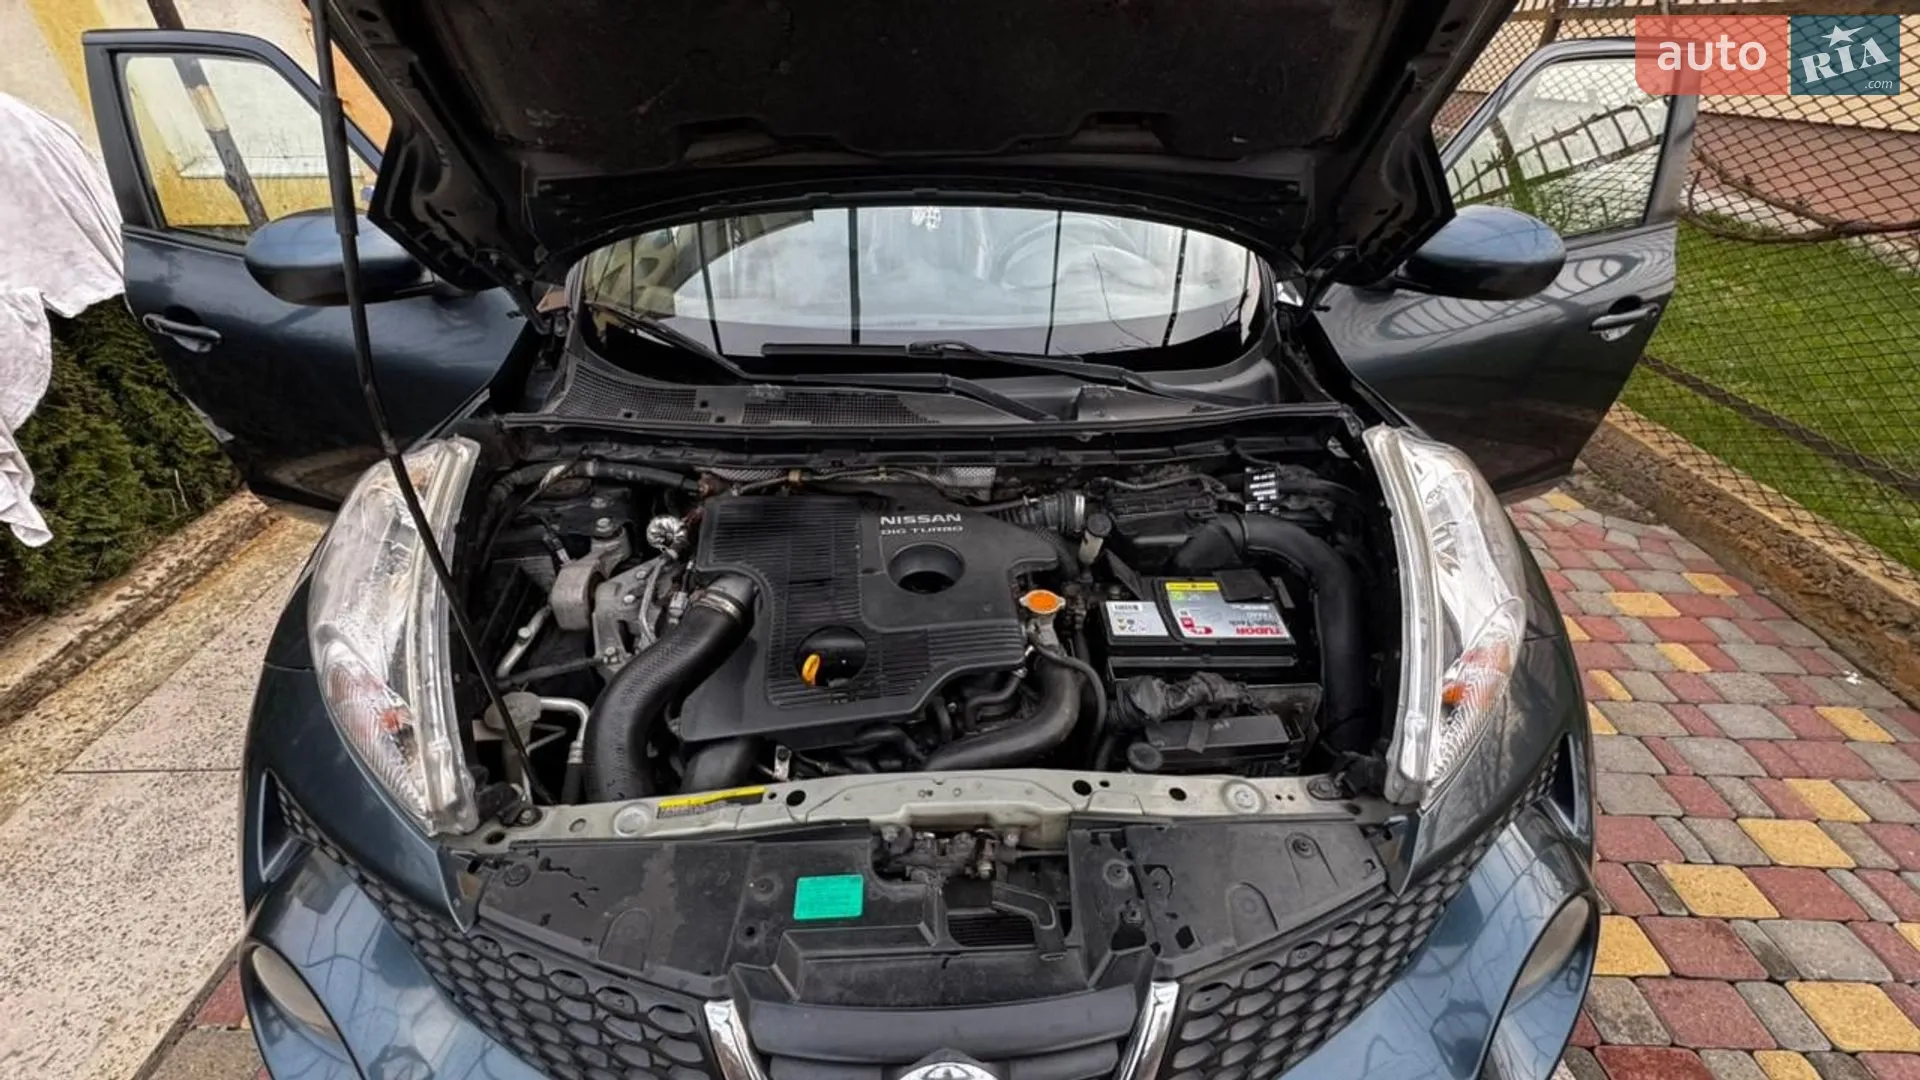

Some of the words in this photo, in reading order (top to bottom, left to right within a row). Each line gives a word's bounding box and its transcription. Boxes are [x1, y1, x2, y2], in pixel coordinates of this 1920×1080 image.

[880, 513, 962, 525] NISSAN
[910, 525, 964, 533] TURBO
[1236, 627, 1283, 636] TUDOR
